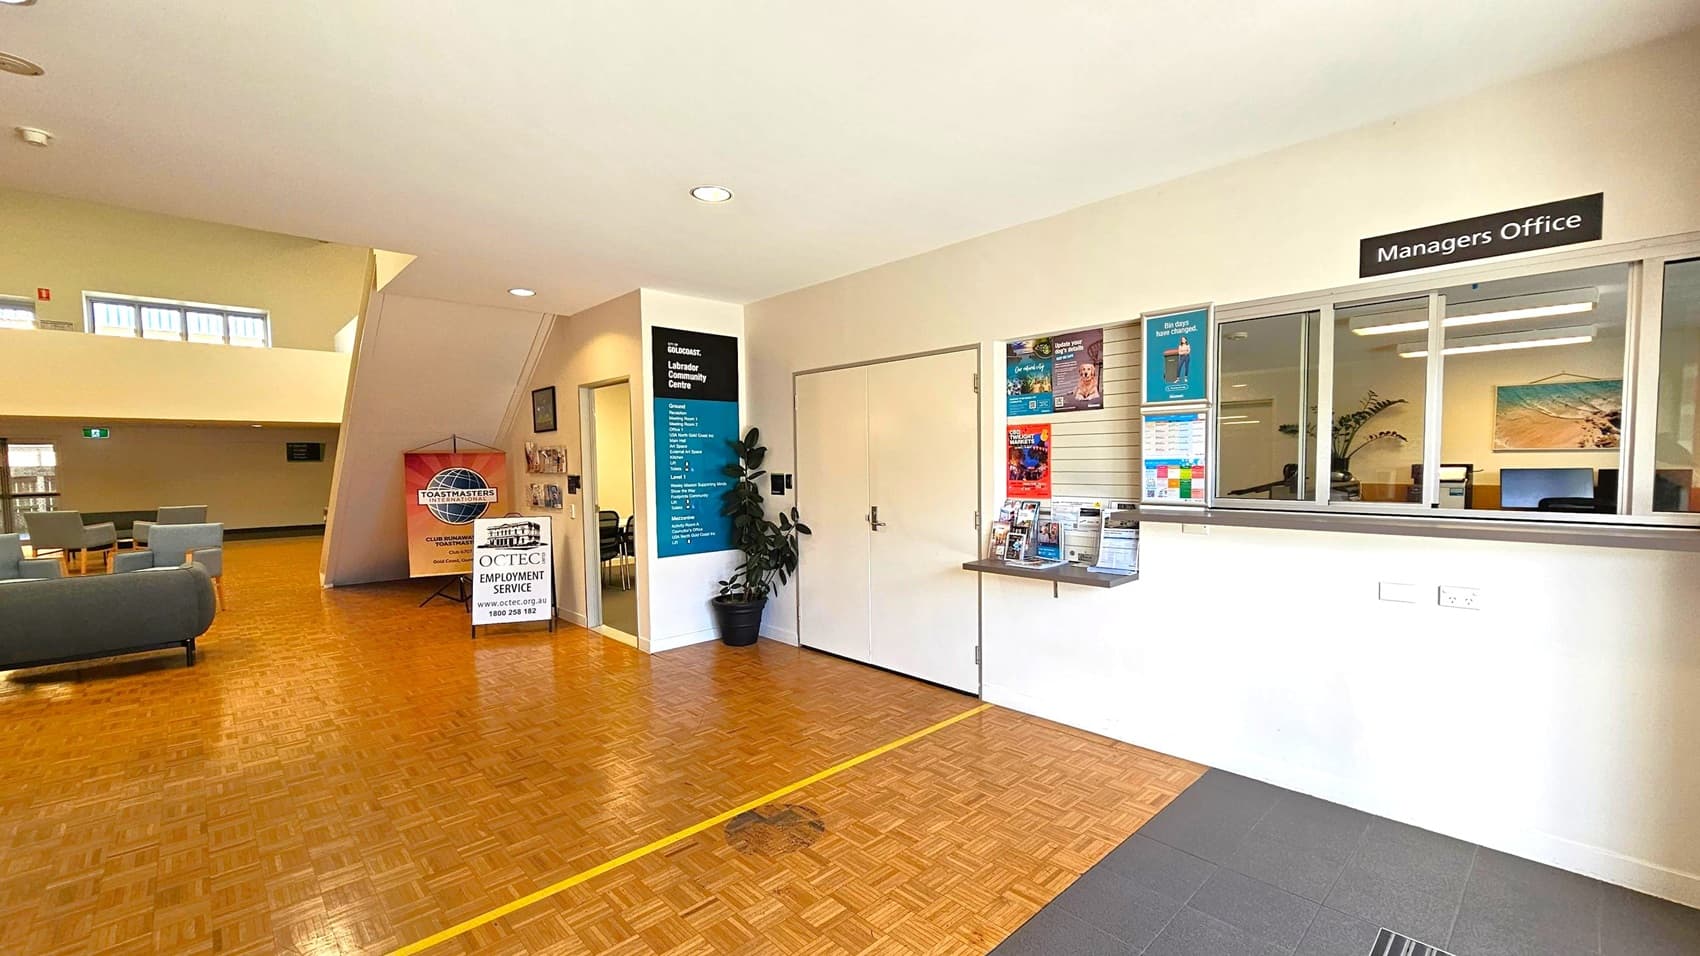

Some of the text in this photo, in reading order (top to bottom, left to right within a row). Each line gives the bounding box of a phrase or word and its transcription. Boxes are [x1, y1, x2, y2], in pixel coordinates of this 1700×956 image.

[1377, 214, 1583, 262] Managers Office
[1175, 320, 1189, 328] days
[1170, 325, 1198, 335] changed.
[1054, 339, 1083, 349] Update your
[1054, 347, 1067, 355] dog's
[668, 360, 699, 371] Labrador
[668, 370, 707, 383] Community
[668, 379, 692, 389] Centre
[421, 489, 495, 498] TOASTMASTERS
[479, 552, 540, 568] OCTEC
[479, 571, 545, 583] EMPLOYMENT
[493, 583, 532, 594] SERVICE
[477, 598, 548, 608] www.octec.org.au
